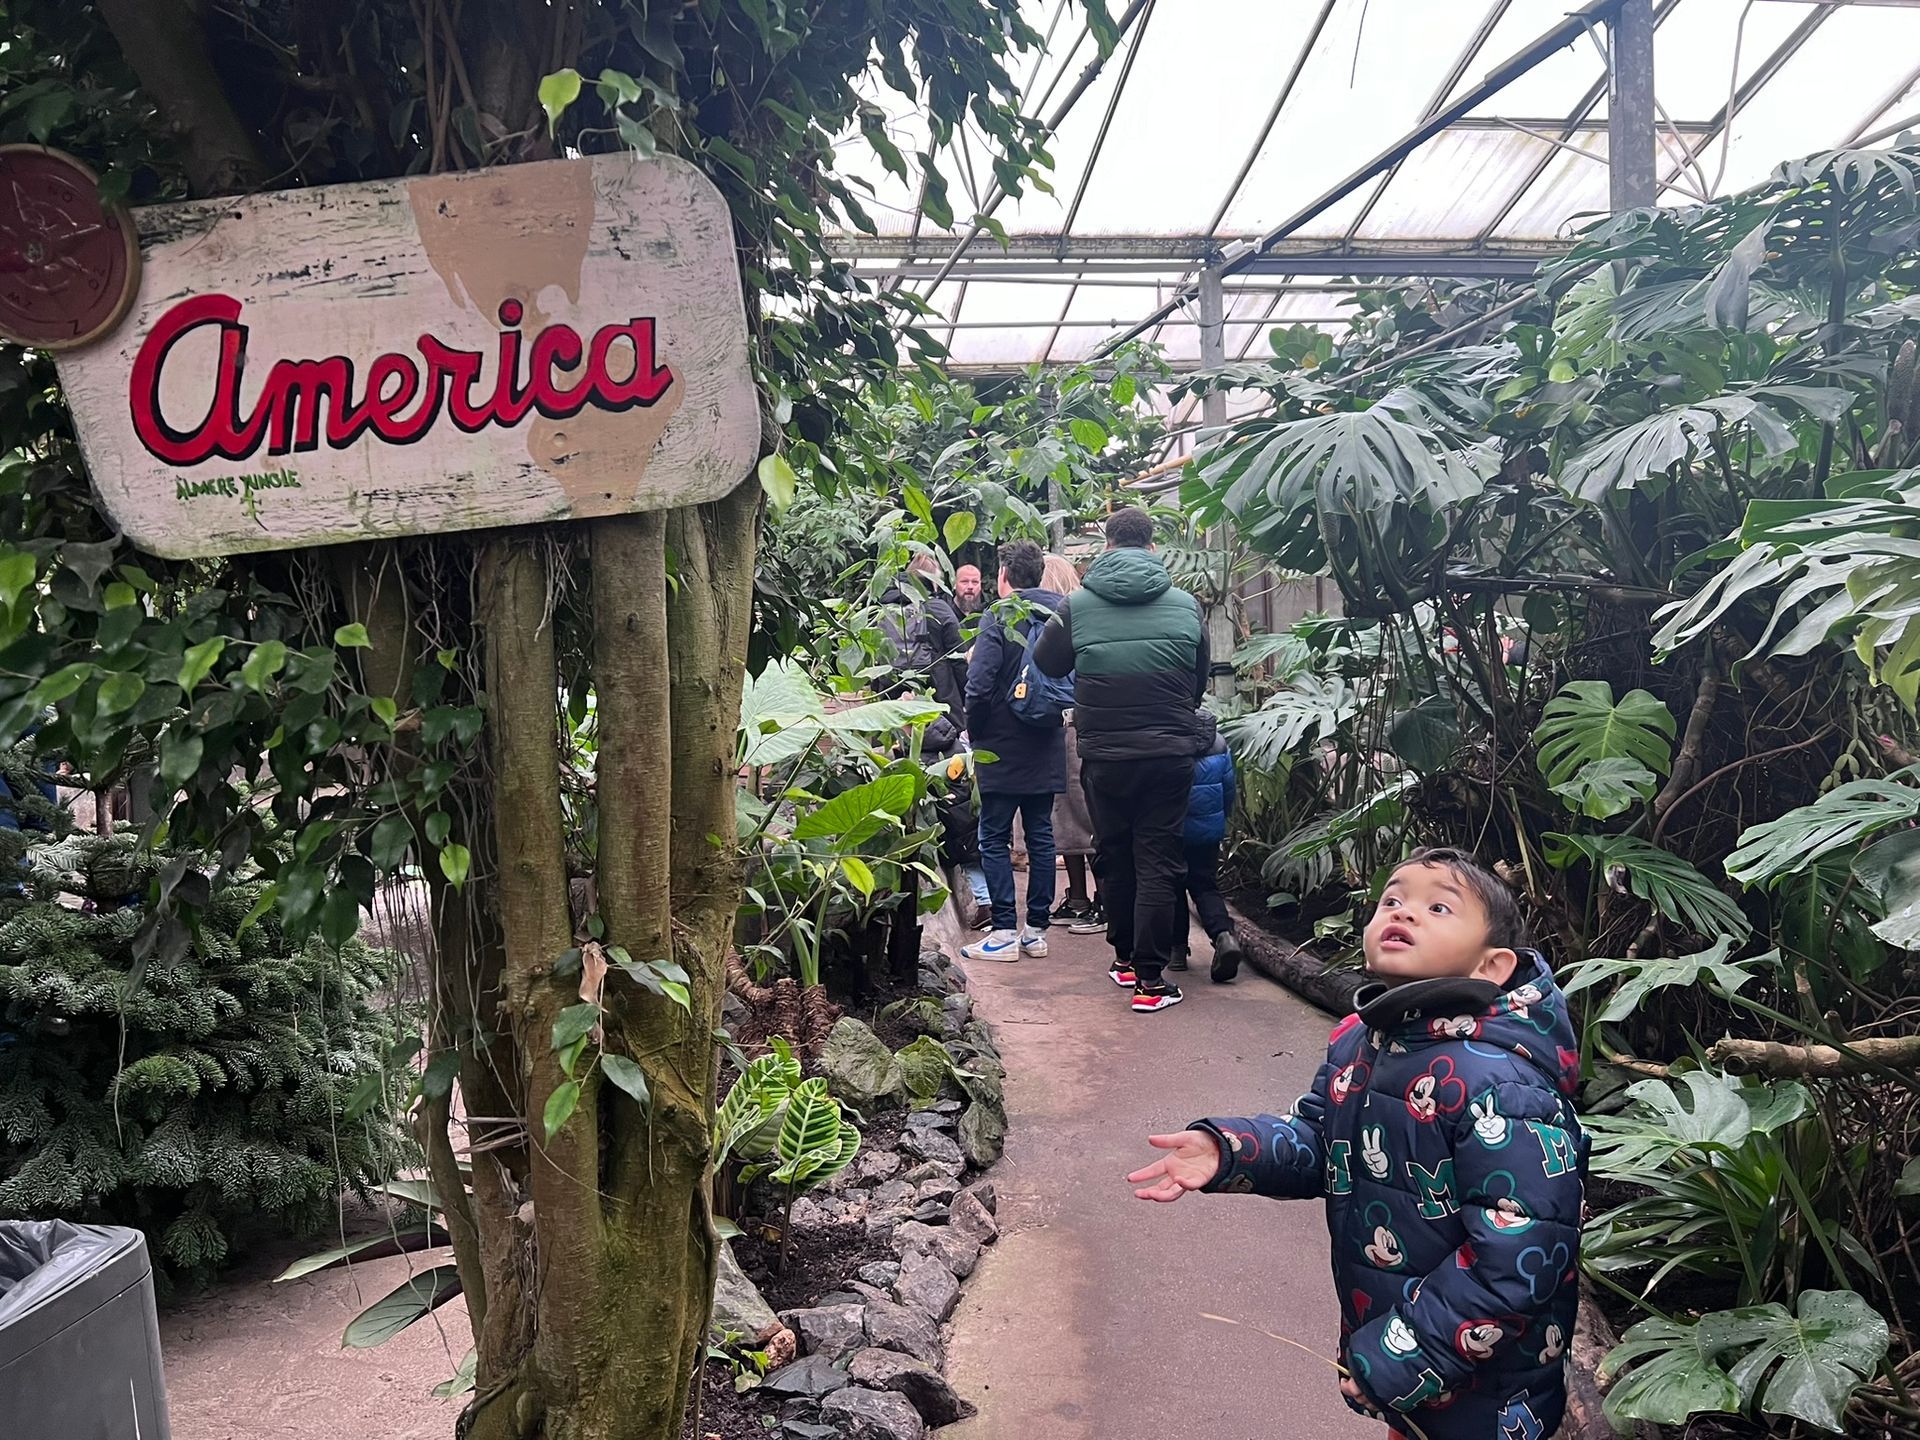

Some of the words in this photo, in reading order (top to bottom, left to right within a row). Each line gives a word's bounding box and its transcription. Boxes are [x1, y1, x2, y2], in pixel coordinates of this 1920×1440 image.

[129, 293, 674, 467] America
[176, 474, 239, 500] ALMERE
[1523, 1117, 1579, 1179] M
[1405, 1158, 1461, 1220] M
